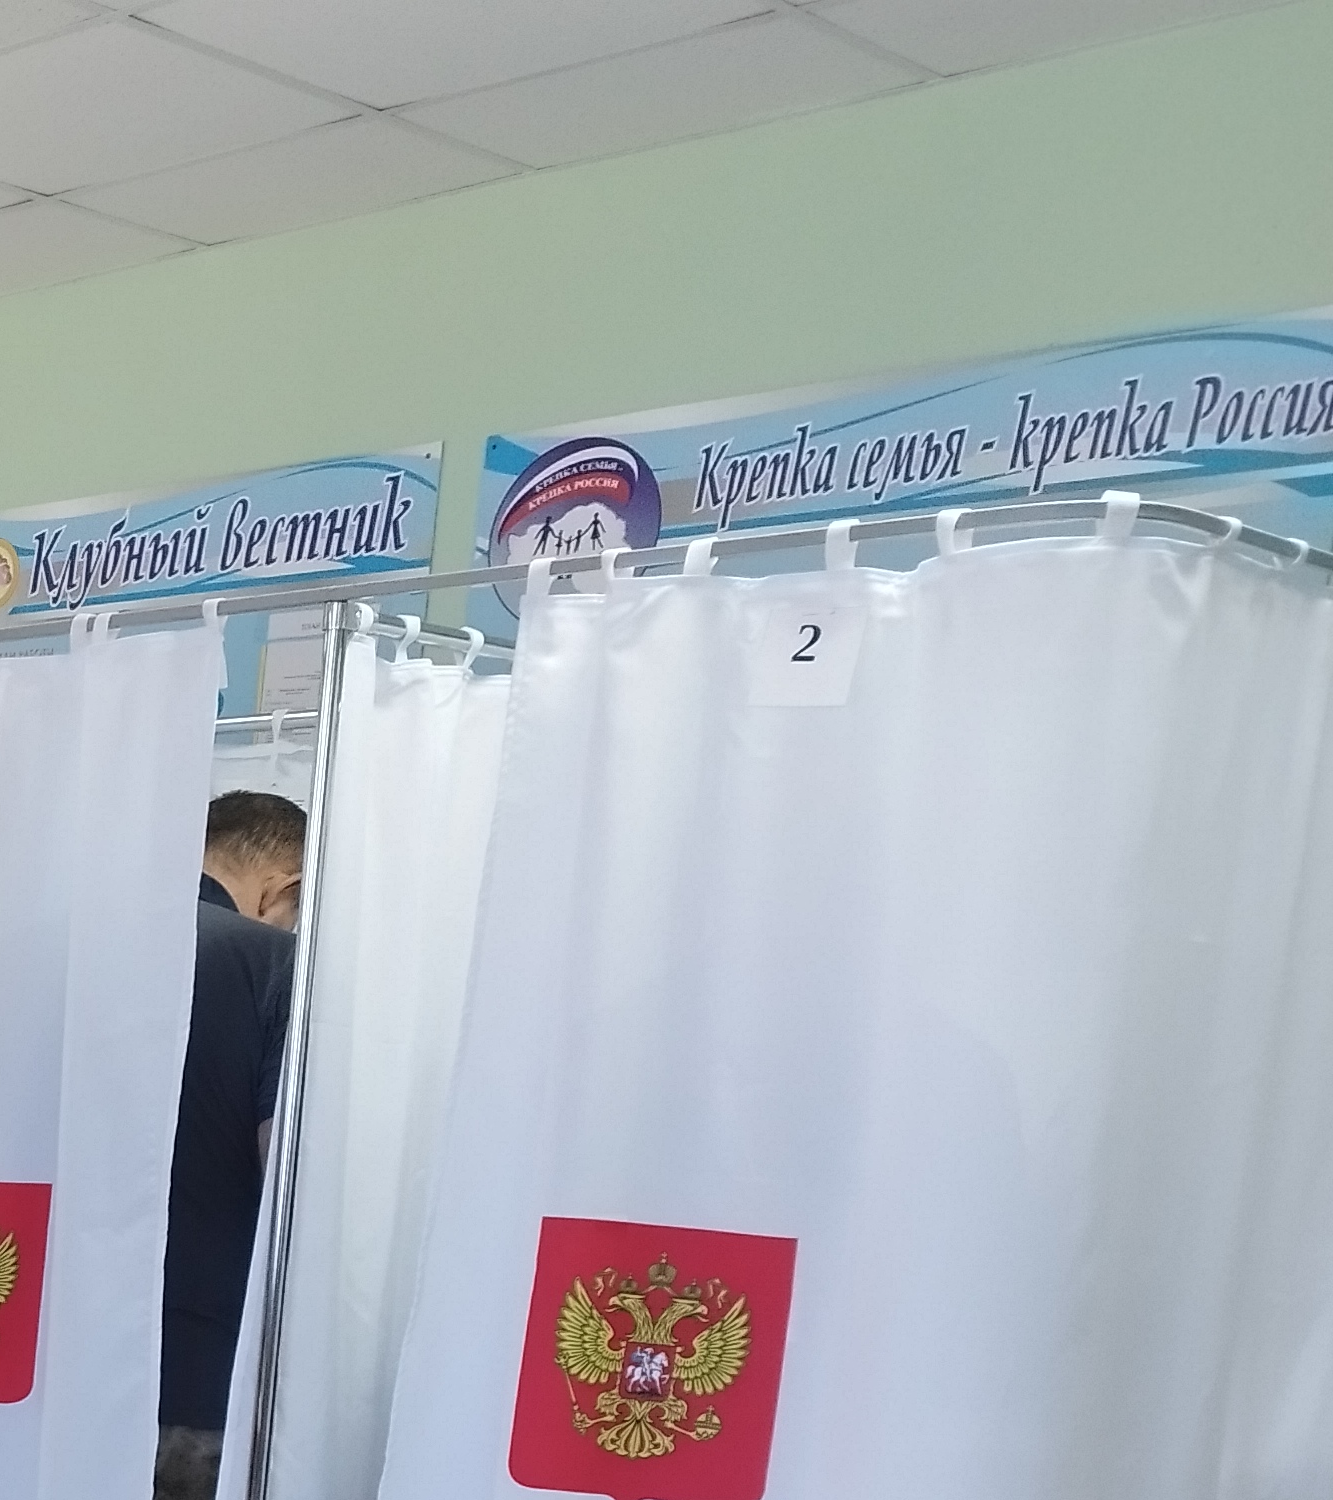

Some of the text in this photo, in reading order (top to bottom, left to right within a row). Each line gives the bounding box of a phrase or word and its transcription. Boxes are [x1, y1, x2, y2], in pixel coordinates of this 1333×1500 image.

[693, 426, 835, 531] Крепка
[846, 427, 967, 501] семья
[1009, 379, 1171, 493] крепка
[1186, 374, 1333, 449] Россия
[528, 477, 620, 511] КРЕПКА РОССИЯ
[535, 466, 579, 493] КРЕПКА
[29, 471, 415, 611] Клубный вестник
[791, 624, 822, 663] 2
